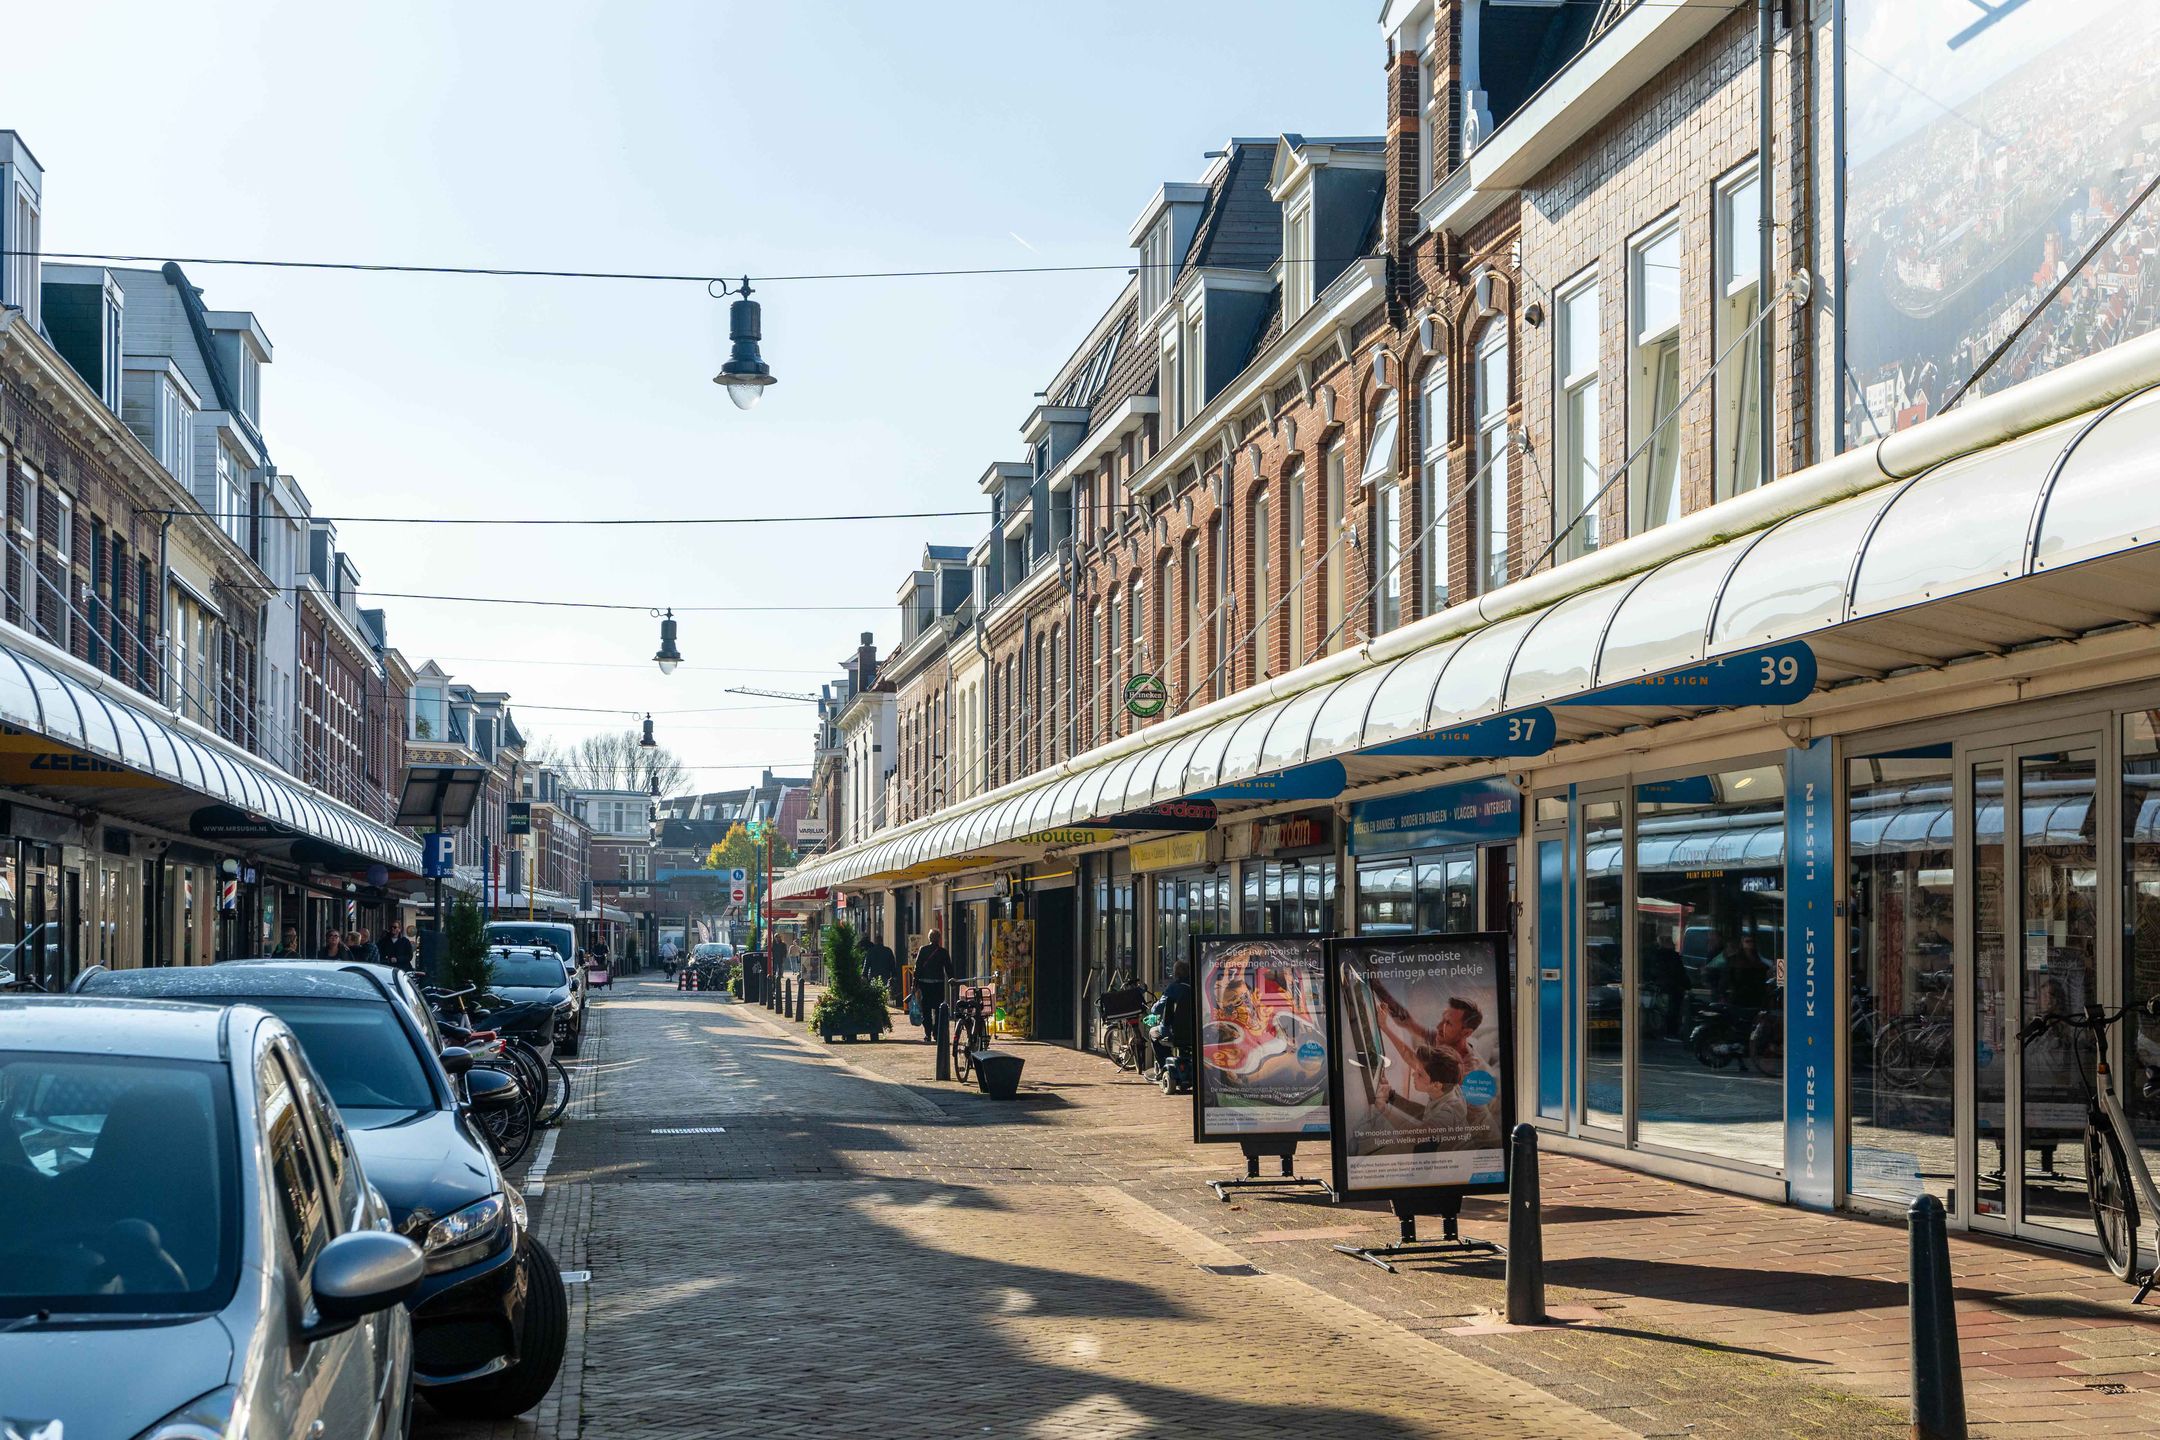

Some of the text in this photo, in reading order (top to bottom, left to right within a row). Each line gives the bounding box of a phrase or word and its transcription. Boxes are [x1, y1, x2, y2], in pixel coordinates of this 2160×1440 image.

[1760, 655, 1799, 686] 39
[1673, 676, 1709, 686] SIGN
[1128, 691, 1163, 700] Hineken
[1441, 733, 1470, 741] SIGN
[1508, 718, 1537, 742] 37
[798, 827, 825, 835] VARILUX
[439, 836, 455, 863] P
[1369, 950, 1462, 965] Geef uw mooiste
[1427, 968, 1448, 977] een
[1450, 964, 1484, 977] plekje
[1805, 782, 1815, 1179] POSTERS KUNST LIJSTEN
[1354, 1130, 1365, 1138] De
[1365, 1129, 1392, 1137] mooiste
[1392, 1128, 1427, 1136] momenten
[1428, 1126, 1447, 1134] horen
[1464, 1123, 1491, 1132] mooiste
[1396, 1136, 1417, 1145] Welke
[1417, 1136, 1431, 1145] past
[1440, 1134, 1457, 1144] jouw
